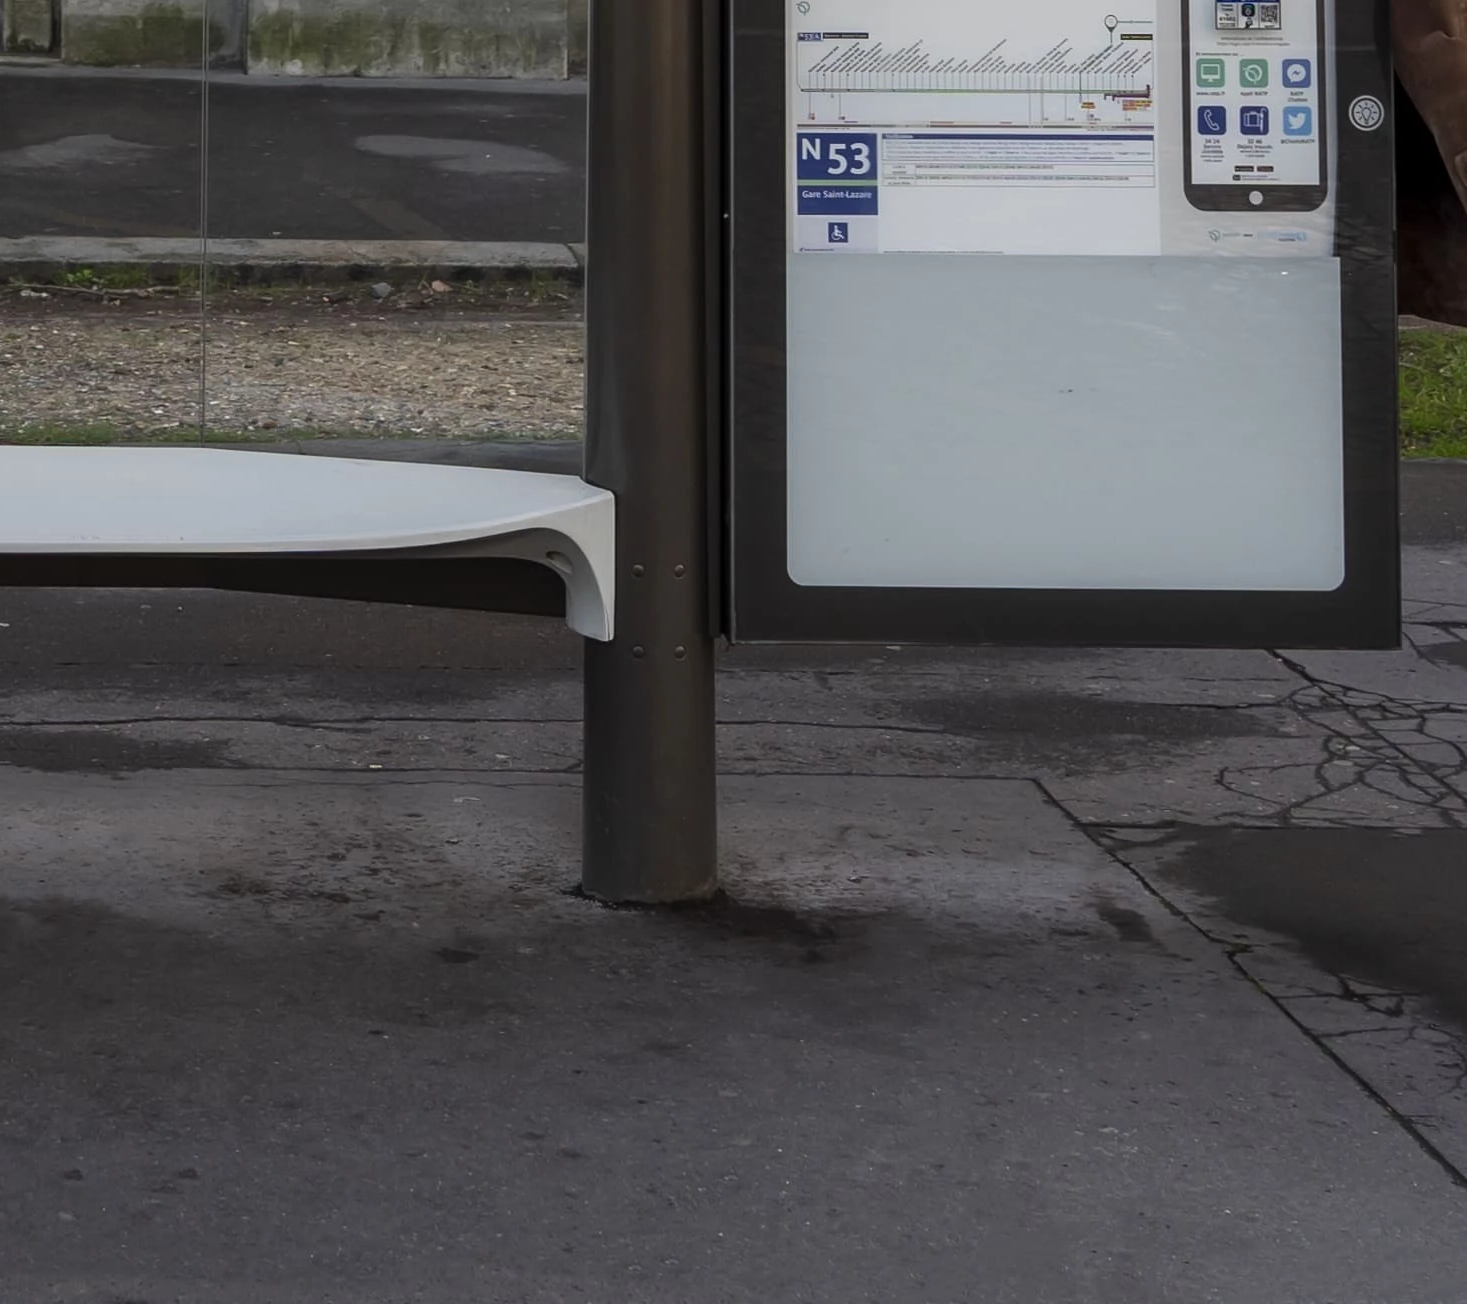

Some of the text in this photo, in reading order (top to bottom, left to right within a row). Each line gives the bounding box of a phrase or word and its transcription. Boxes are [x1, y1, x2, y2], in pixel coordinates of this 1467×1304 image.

[827, 142, 871, 175] 53
[802, 190, 872, 200] Gare Saint-Lazare
